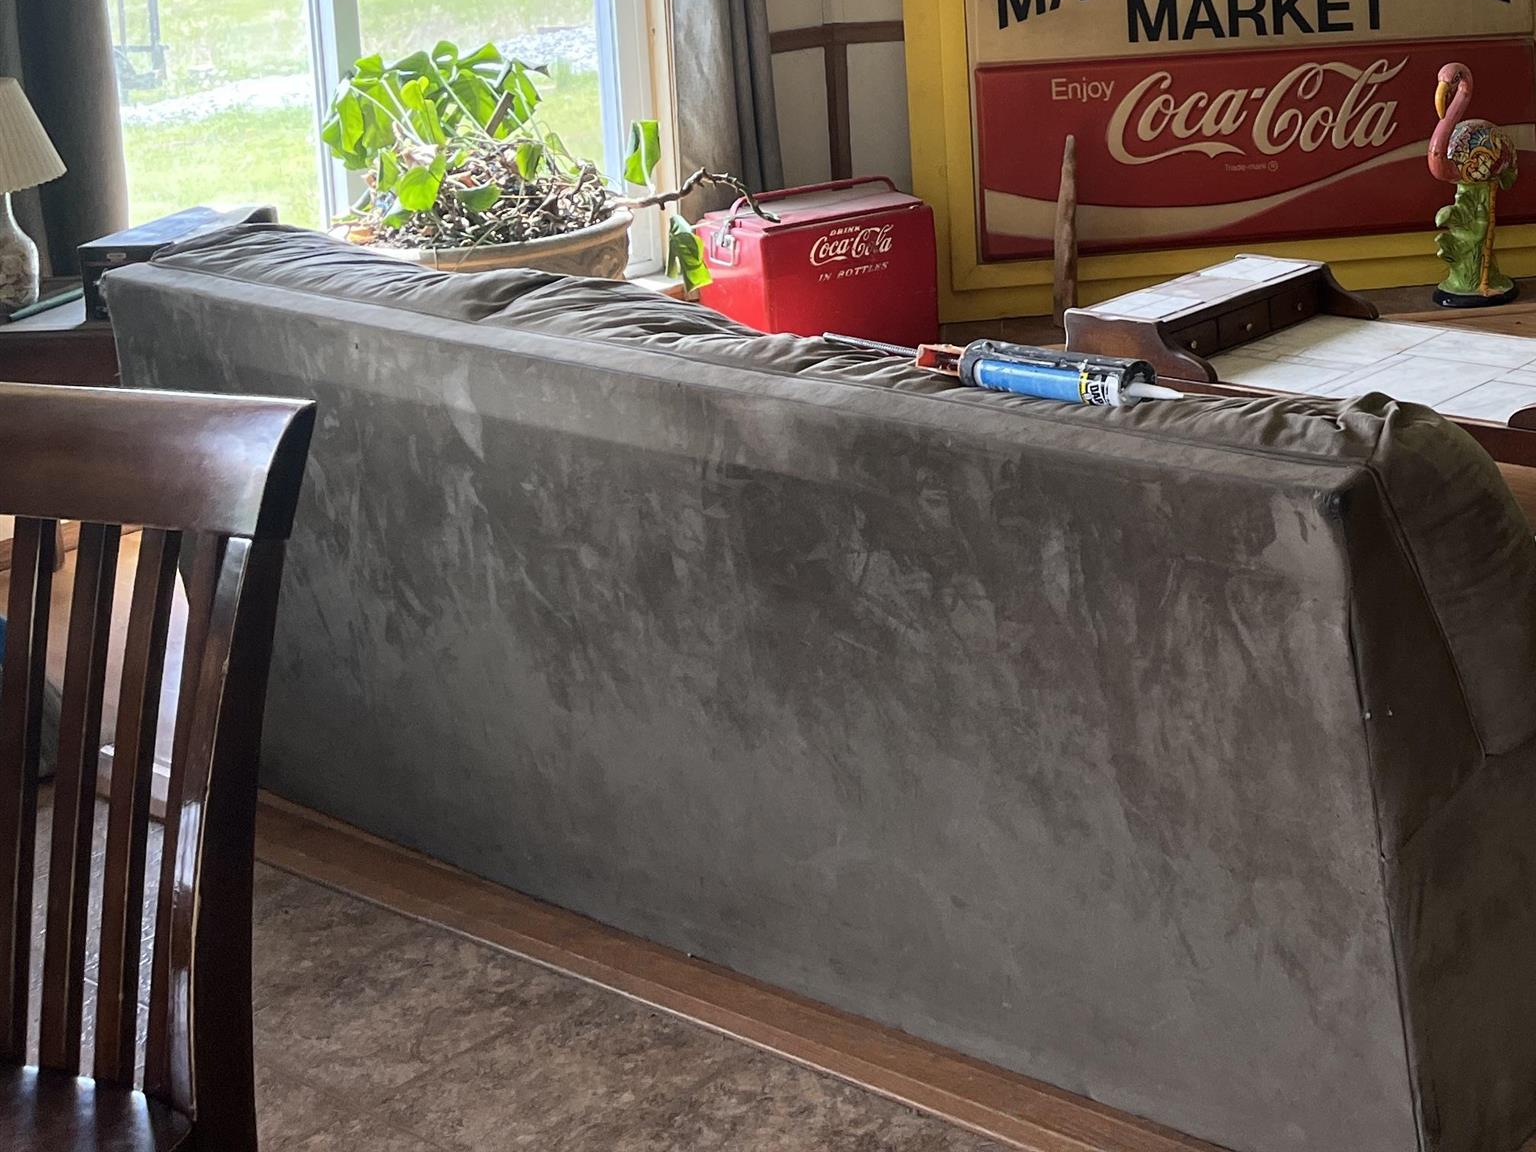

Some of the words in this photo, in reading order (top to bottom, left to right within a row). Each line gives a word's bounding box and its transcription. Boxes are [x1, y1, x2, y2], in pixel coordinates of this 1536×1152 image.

[1050, 76, 1115, 103] Enjoy
[1106, 55, 1410, 166] Coca-Cola
[829, 225, 861, 237] DRINK
[809, 224, 894, 266] Coca-Cola
[817, 273, 832, 283] IN
[837, 261, 889, 279] BOTTLES
[1089, 384, 1104, 404] DAP
